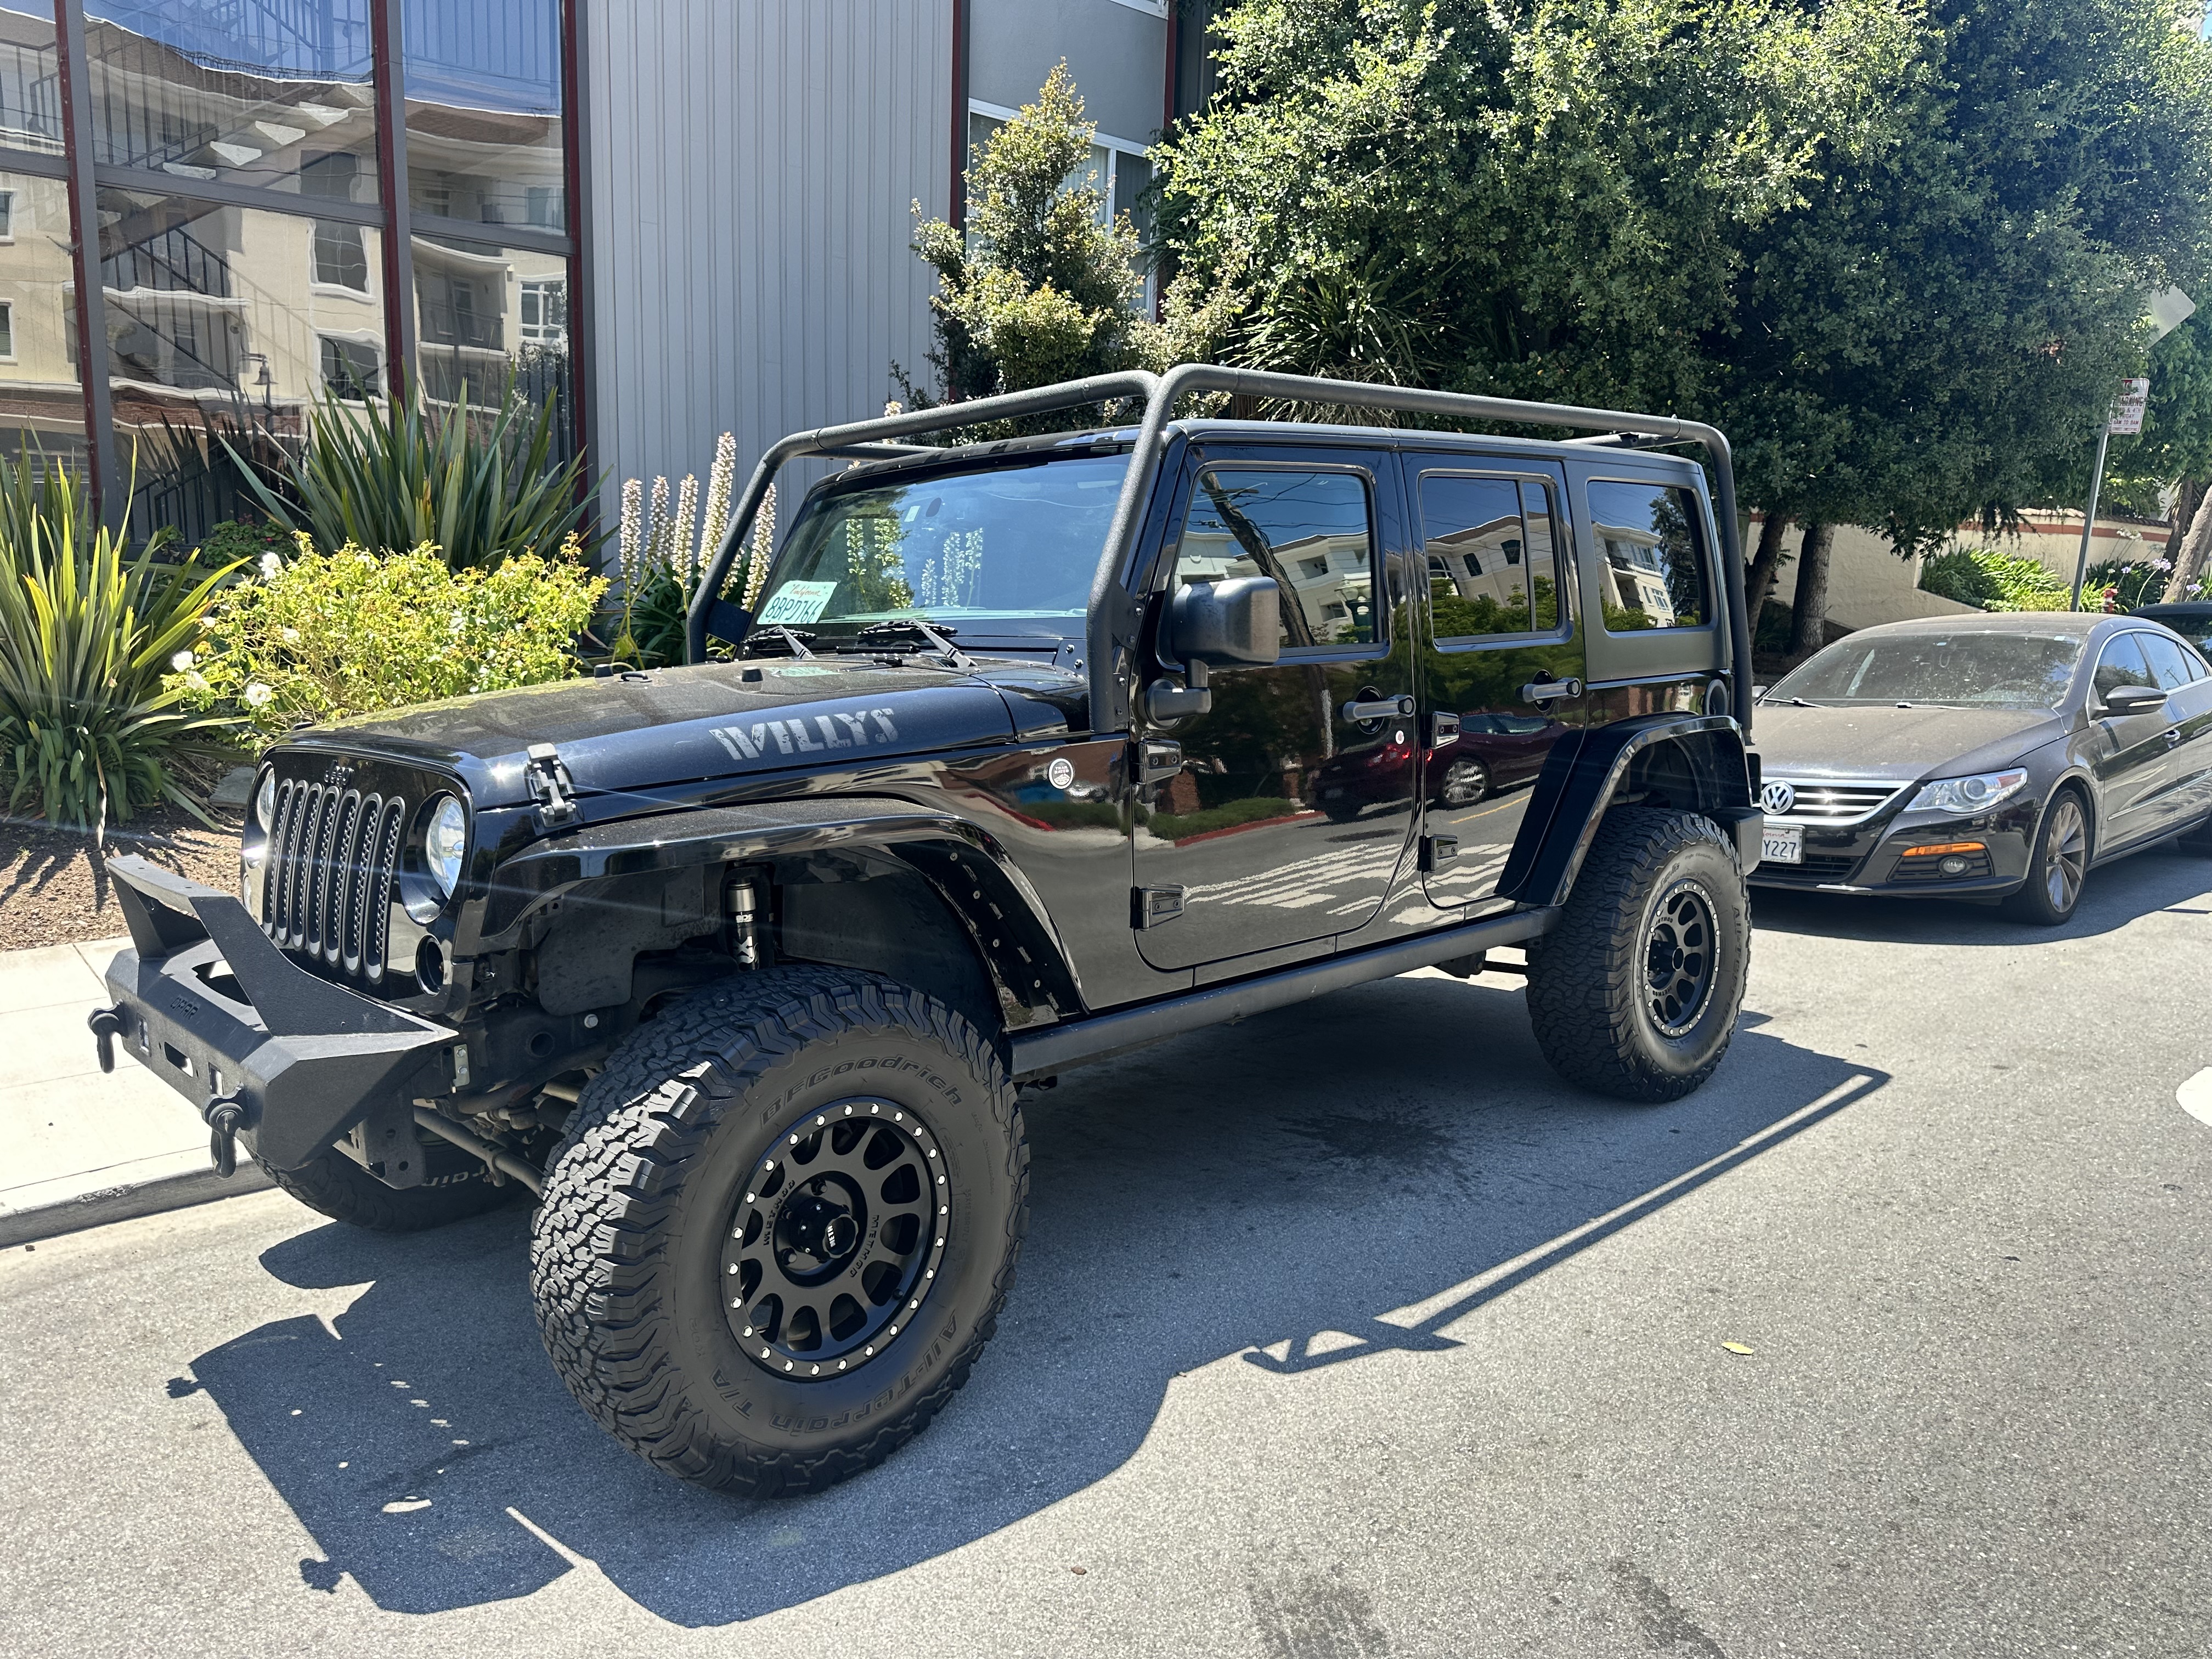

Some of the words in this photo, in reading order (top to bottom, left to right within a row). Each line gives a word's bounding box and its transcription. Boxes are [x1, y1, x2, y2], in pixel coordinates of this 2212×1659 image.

[765, 596, 823, 624] 8BPD766
[709, 708, 898, 760] WILLYS
[324, 759, 354, 789] Jeep
[1763, 839, 1797, 858] Y227
[760, 1054, 963, 1129] BFGoodrich
[763, 1180, 795, 1246] METHOD
[849, 1214, 879, 1278] METHOD
[769, 1309, 958, 1437] All-Terrain
